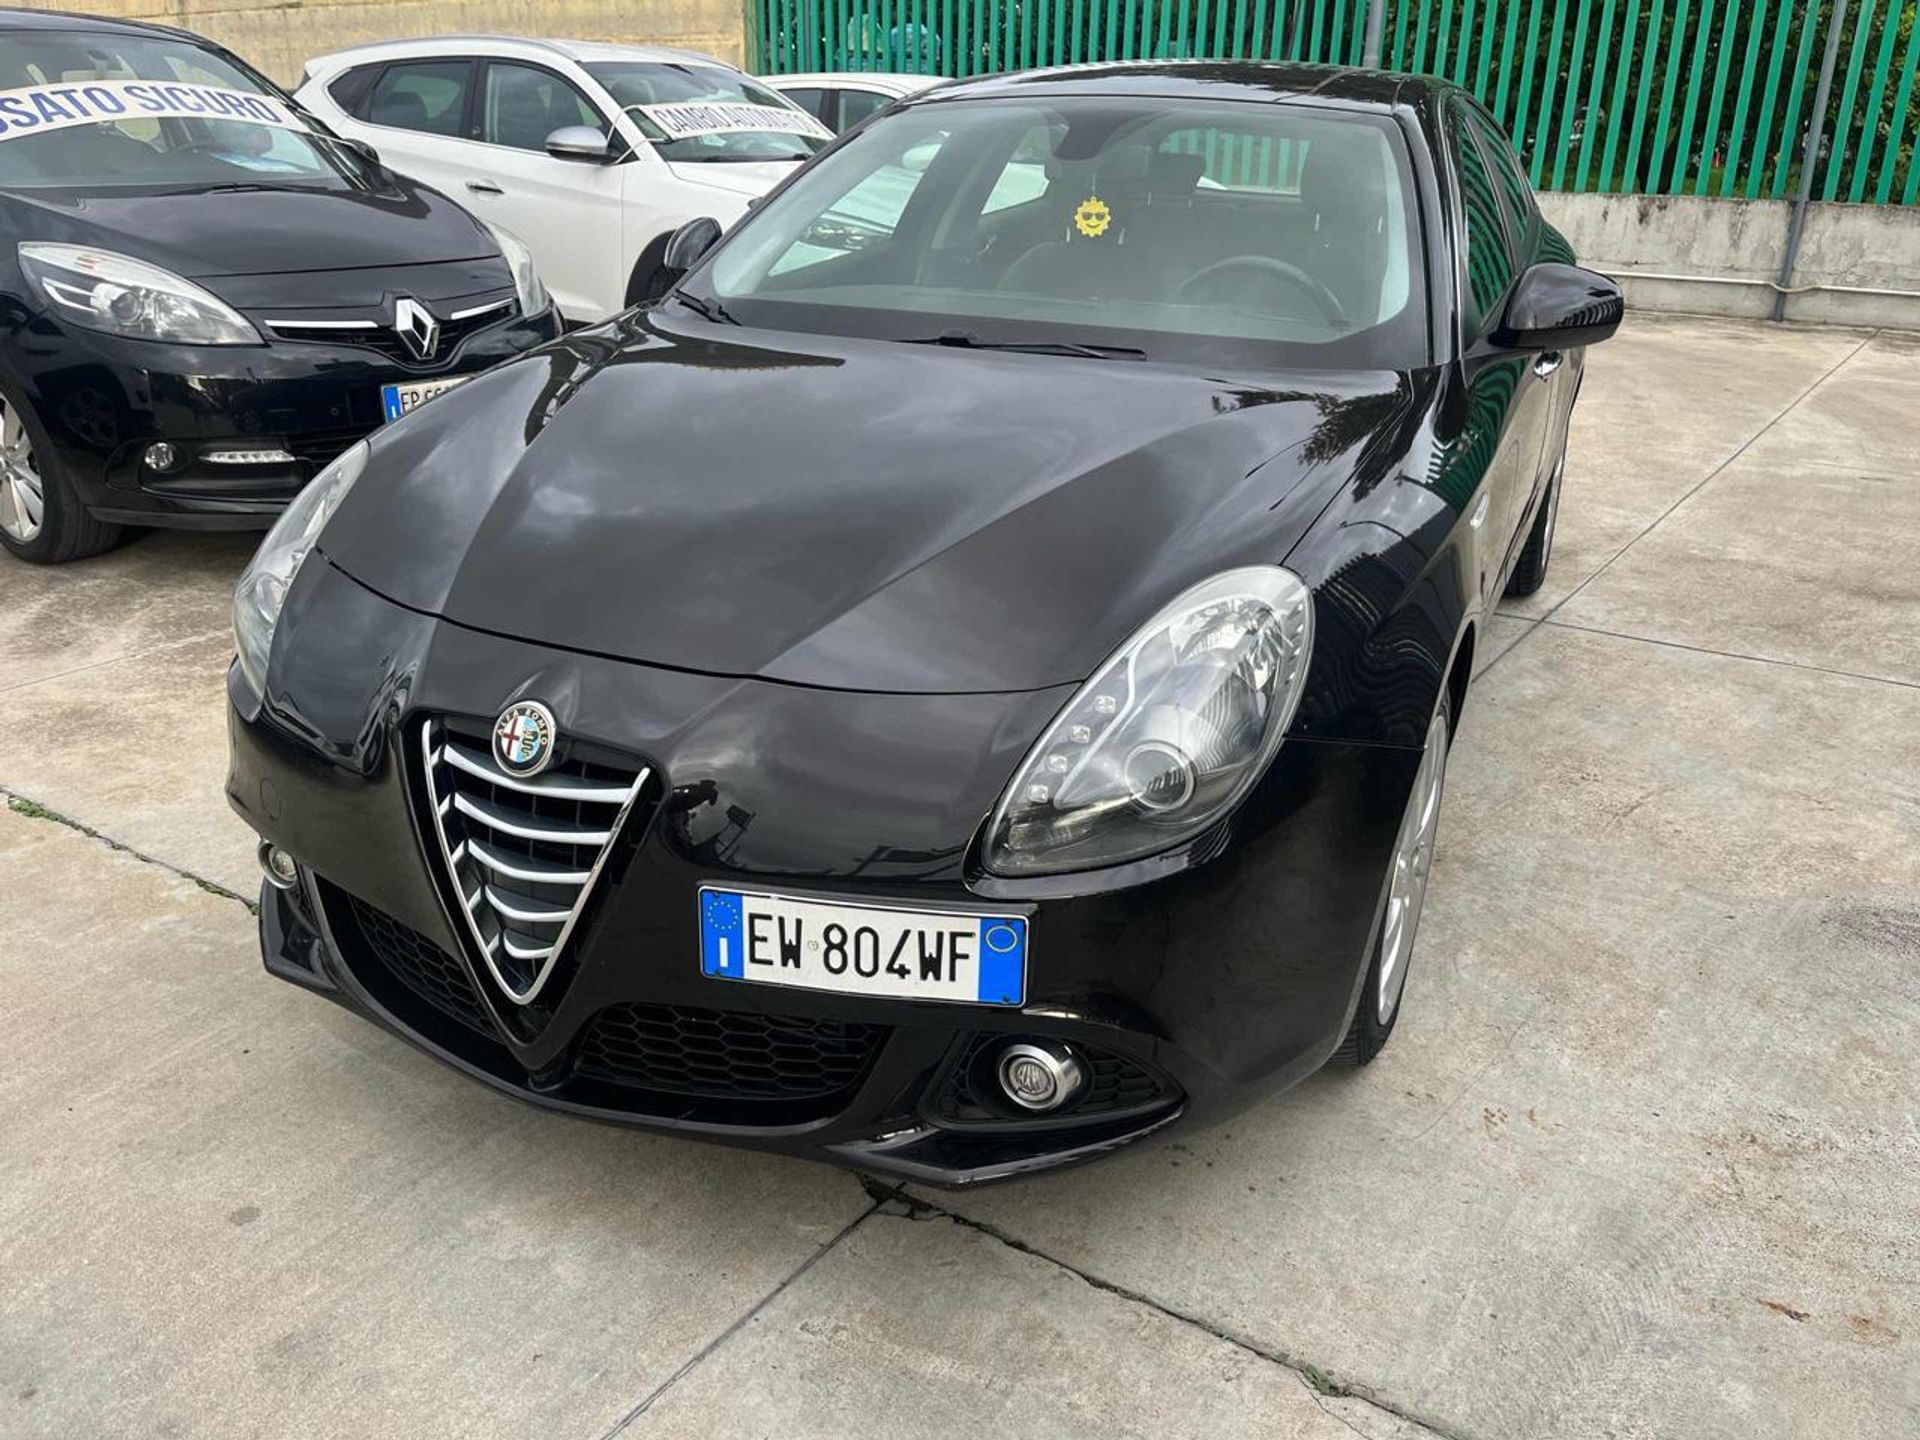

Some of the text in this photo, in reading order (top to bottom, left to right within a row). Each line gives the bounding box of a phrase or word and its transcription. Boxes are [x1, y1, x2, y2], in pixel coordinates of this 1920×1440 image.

[123, 85, 282, 124] SICURO
[653, 106, 732, 132] CAMBIO
[497, 707, 548, 745] ALFA ROMEO
[748, 912, 977, 982] EW 804WF
